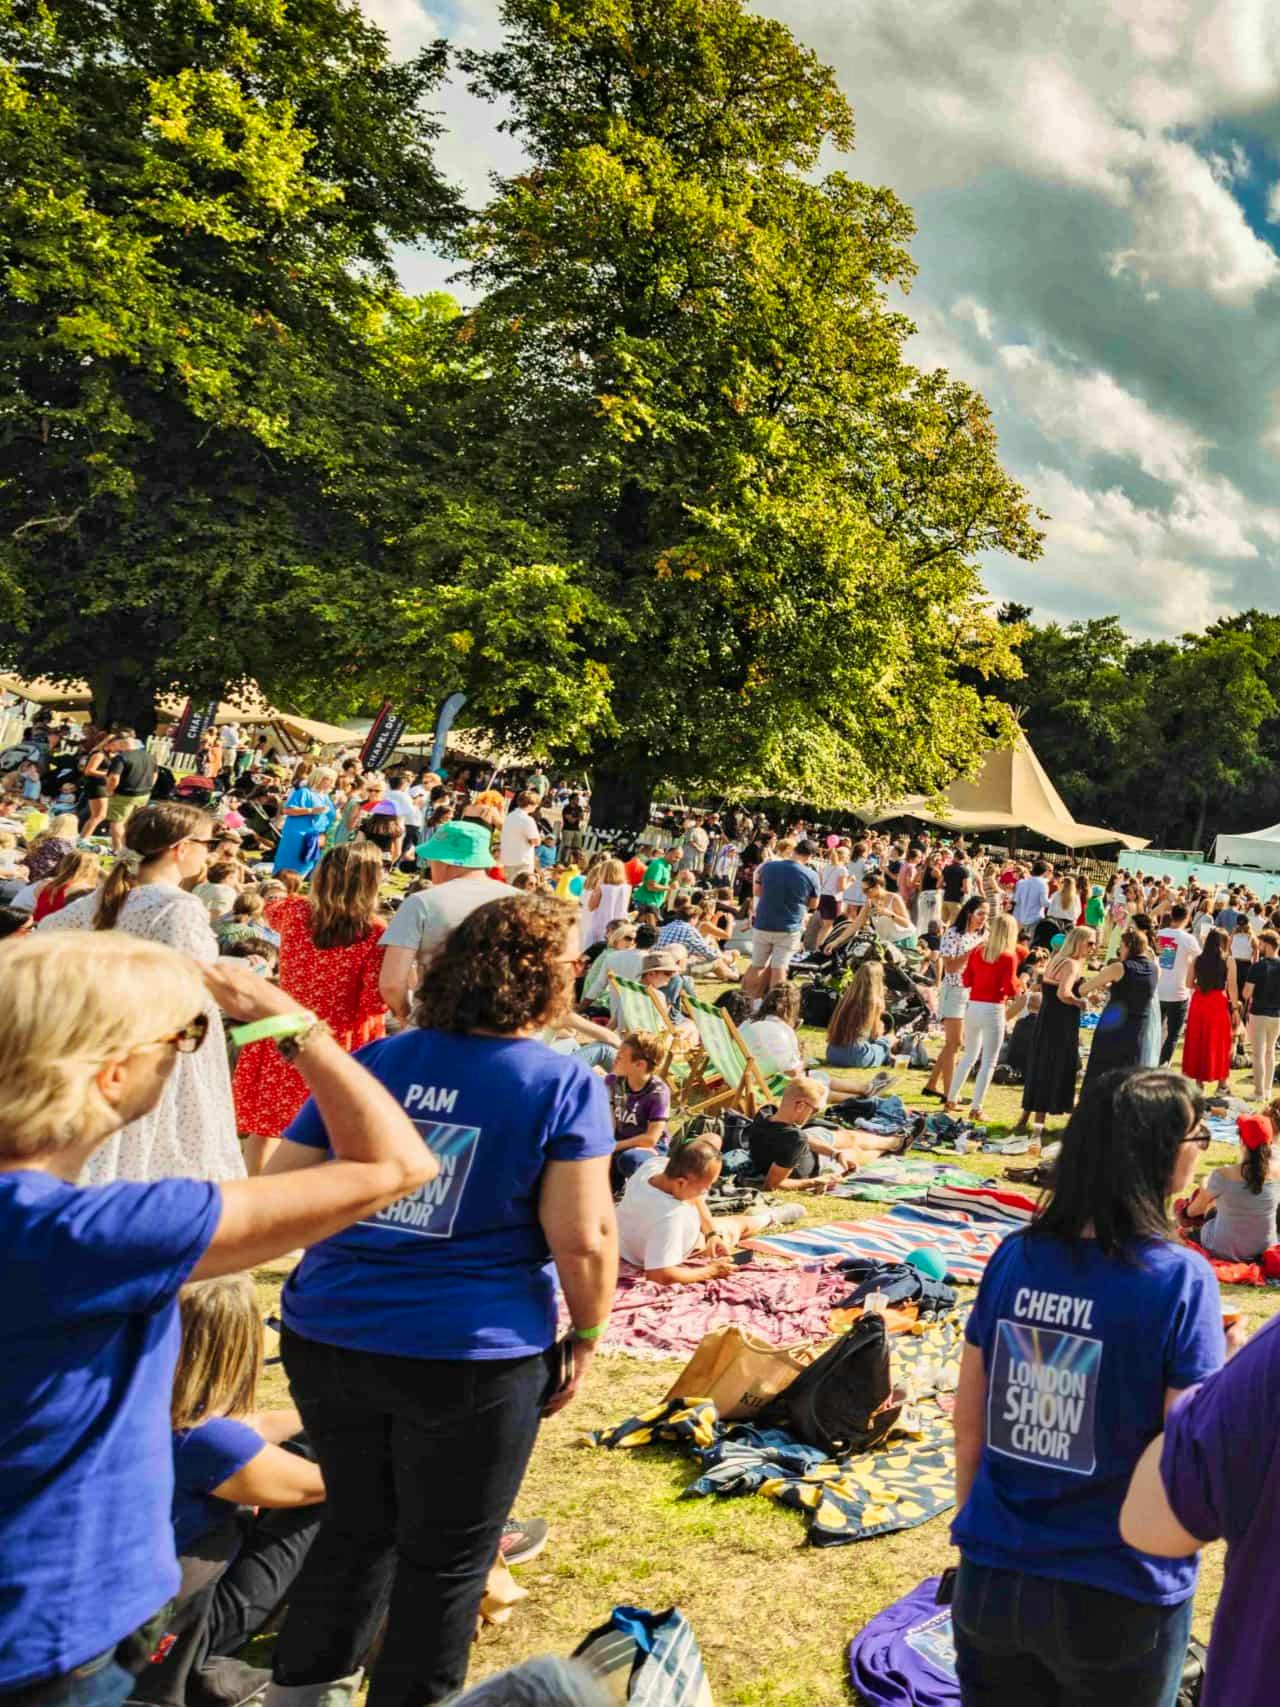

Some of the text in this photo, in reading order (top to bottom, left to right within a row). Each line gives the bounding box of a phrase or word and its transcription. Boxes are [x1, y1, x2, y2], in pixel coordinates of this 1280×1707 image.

[367, 731, 390, 768] CHAPEL
[403, 1084, 459, 1113] PAM
[1013, 1287, 1094, 1330] CHERYL
[1008, 1357, 1087, 1398] LONDON
[1003, 1385, 1085, 1435] SHOW
[1011, 1423, 1071, 1461] CHOIR
